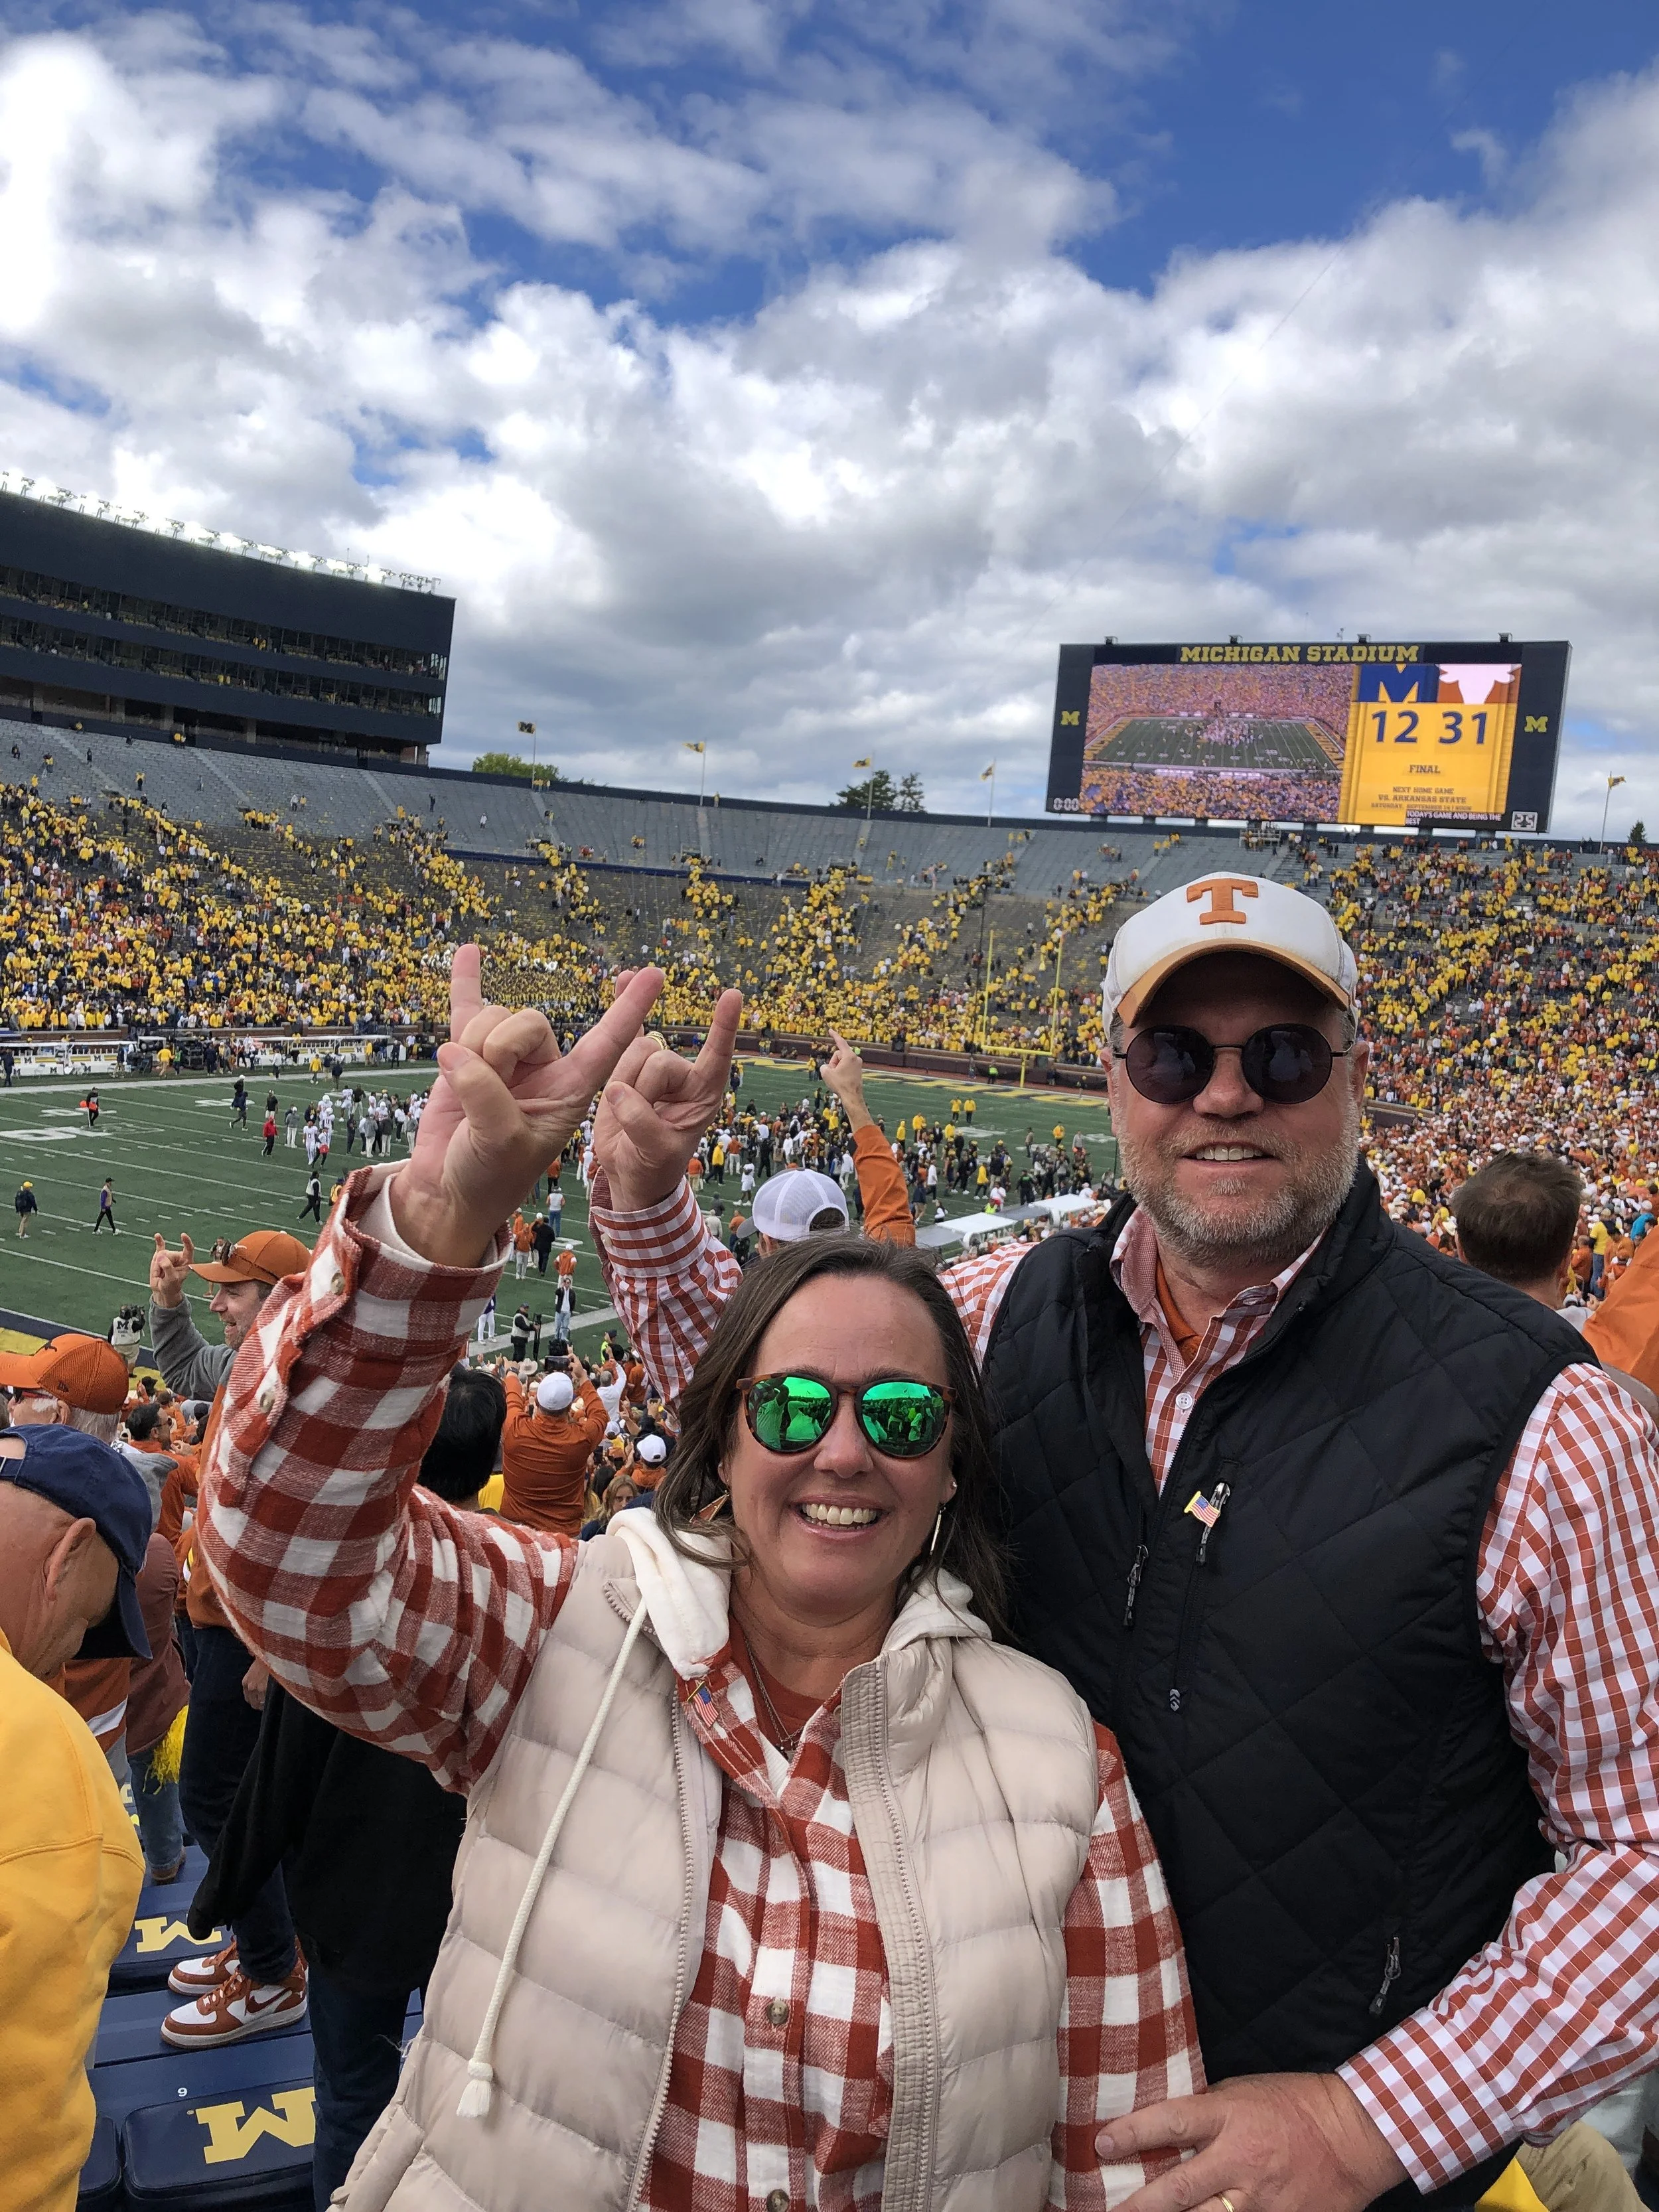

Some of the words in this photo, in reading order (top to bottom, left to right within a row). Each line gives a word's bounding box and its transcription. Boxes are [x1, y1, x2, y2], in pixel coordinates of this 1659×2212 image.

[1181, 646, 1301, 662] MICHIGAN
[1306, 645, 1419, 662] STADIUM
[1060, 711, 1080, 725] M
[1524, 715, 1549, 733] M
[1372, 710, 1419, 743] 12
[1438, 711, 1488, 744] 31
[1409, 765, 1441, 774] FINAL
[1407, 810, 1433, 819] TODAY'S
[1433, 811, 1452, 820] GAME
[1469, 812, 1488, 821] BEING
[1187, 878, 1259, 925] T
[117, 1320, 129, 1330] M
[195, 2085, 317, 2164] M
